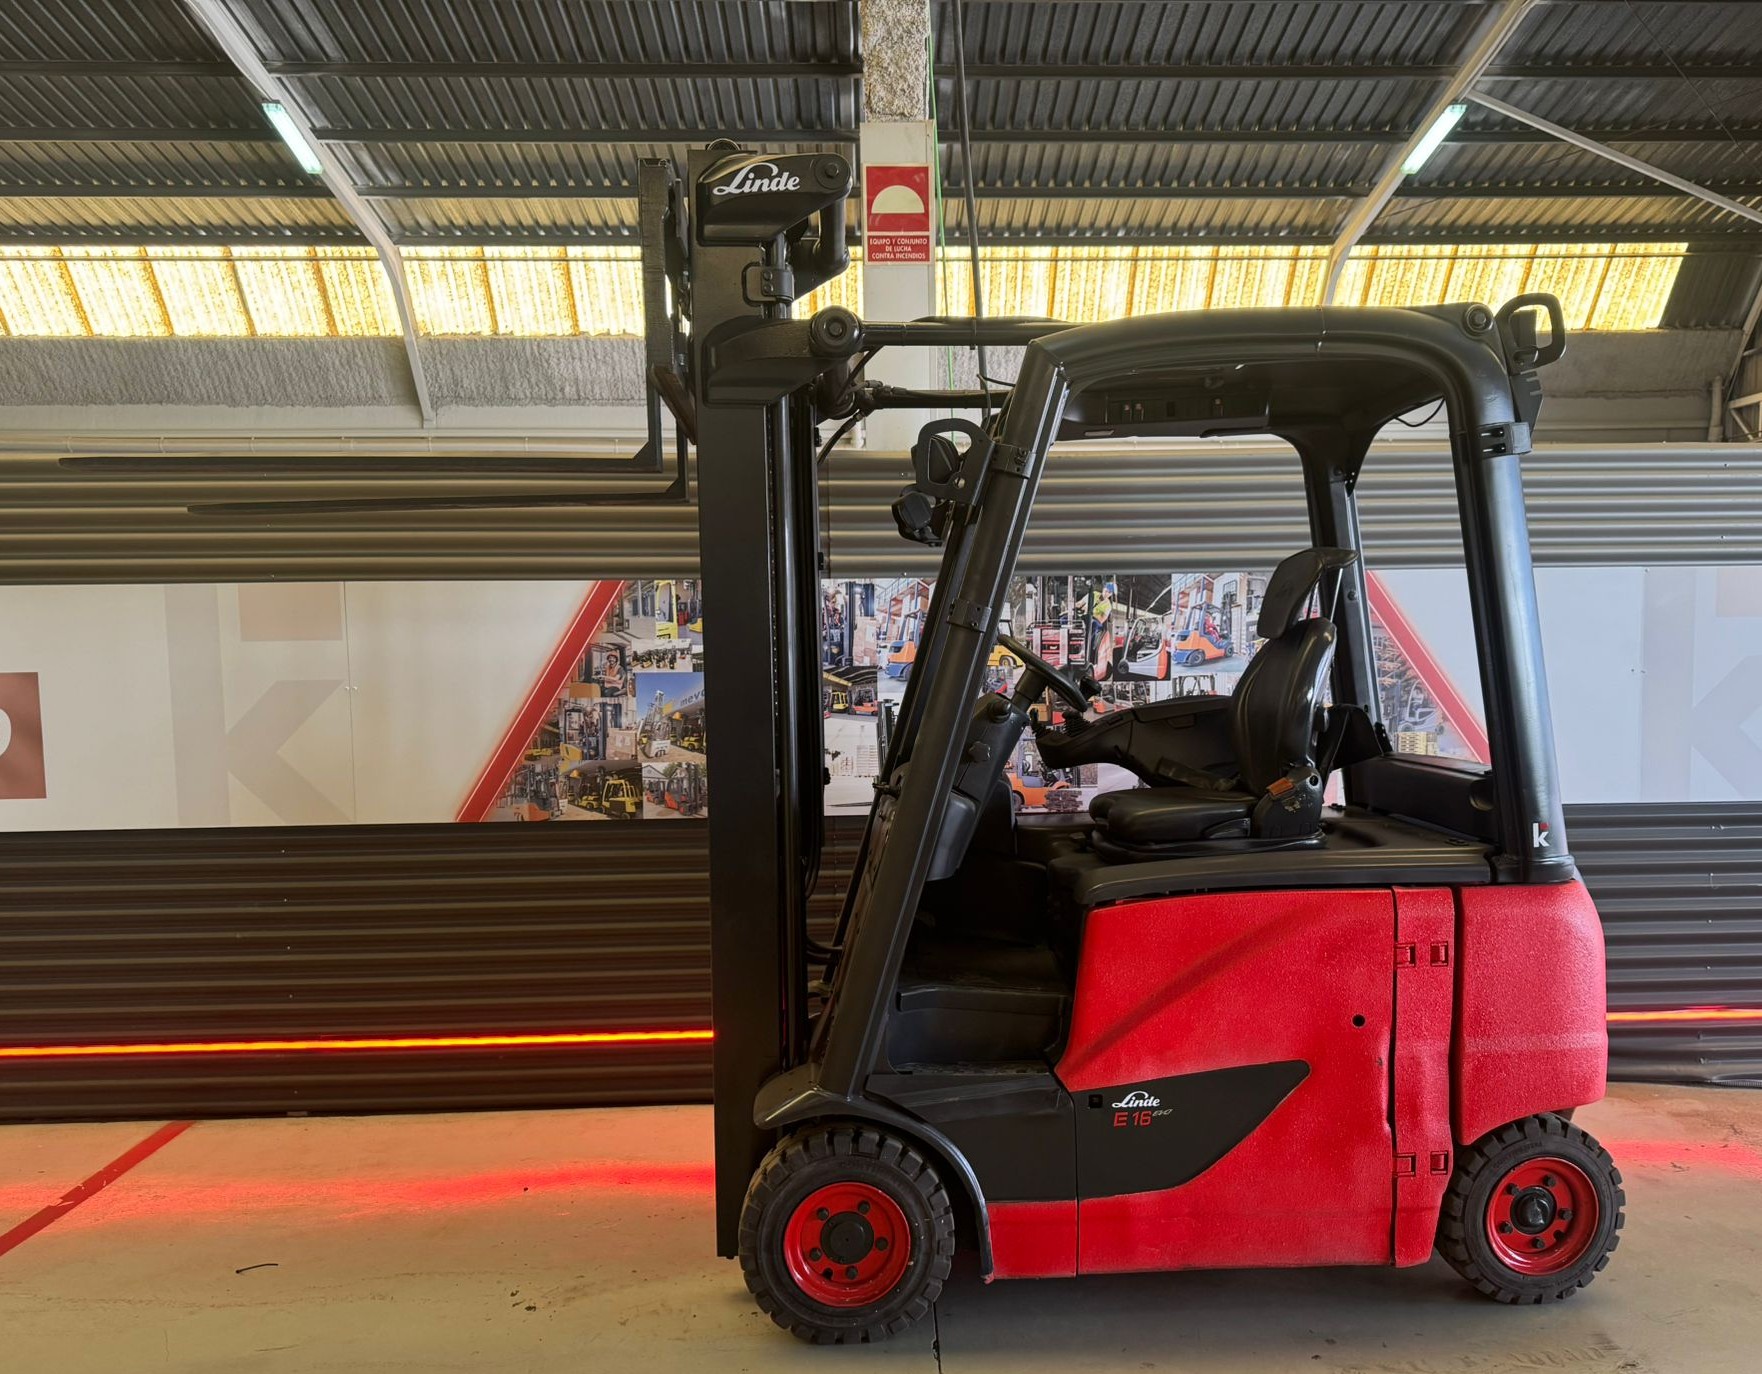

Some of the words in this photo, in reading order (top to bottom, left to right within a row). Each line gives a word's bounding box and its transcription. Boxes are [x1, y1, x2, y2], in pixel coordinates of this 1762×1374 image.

[713, 162, 800, 195] Linde
[871, 252, 895, 260] CONTRA
[895, 252, 926, 260] INCENDIOS
[1111, 1090, 1160, 1108] Linde
[1114, 1111, 1129, 1127] E
[1132, 1110, 1152, 1127] 16
